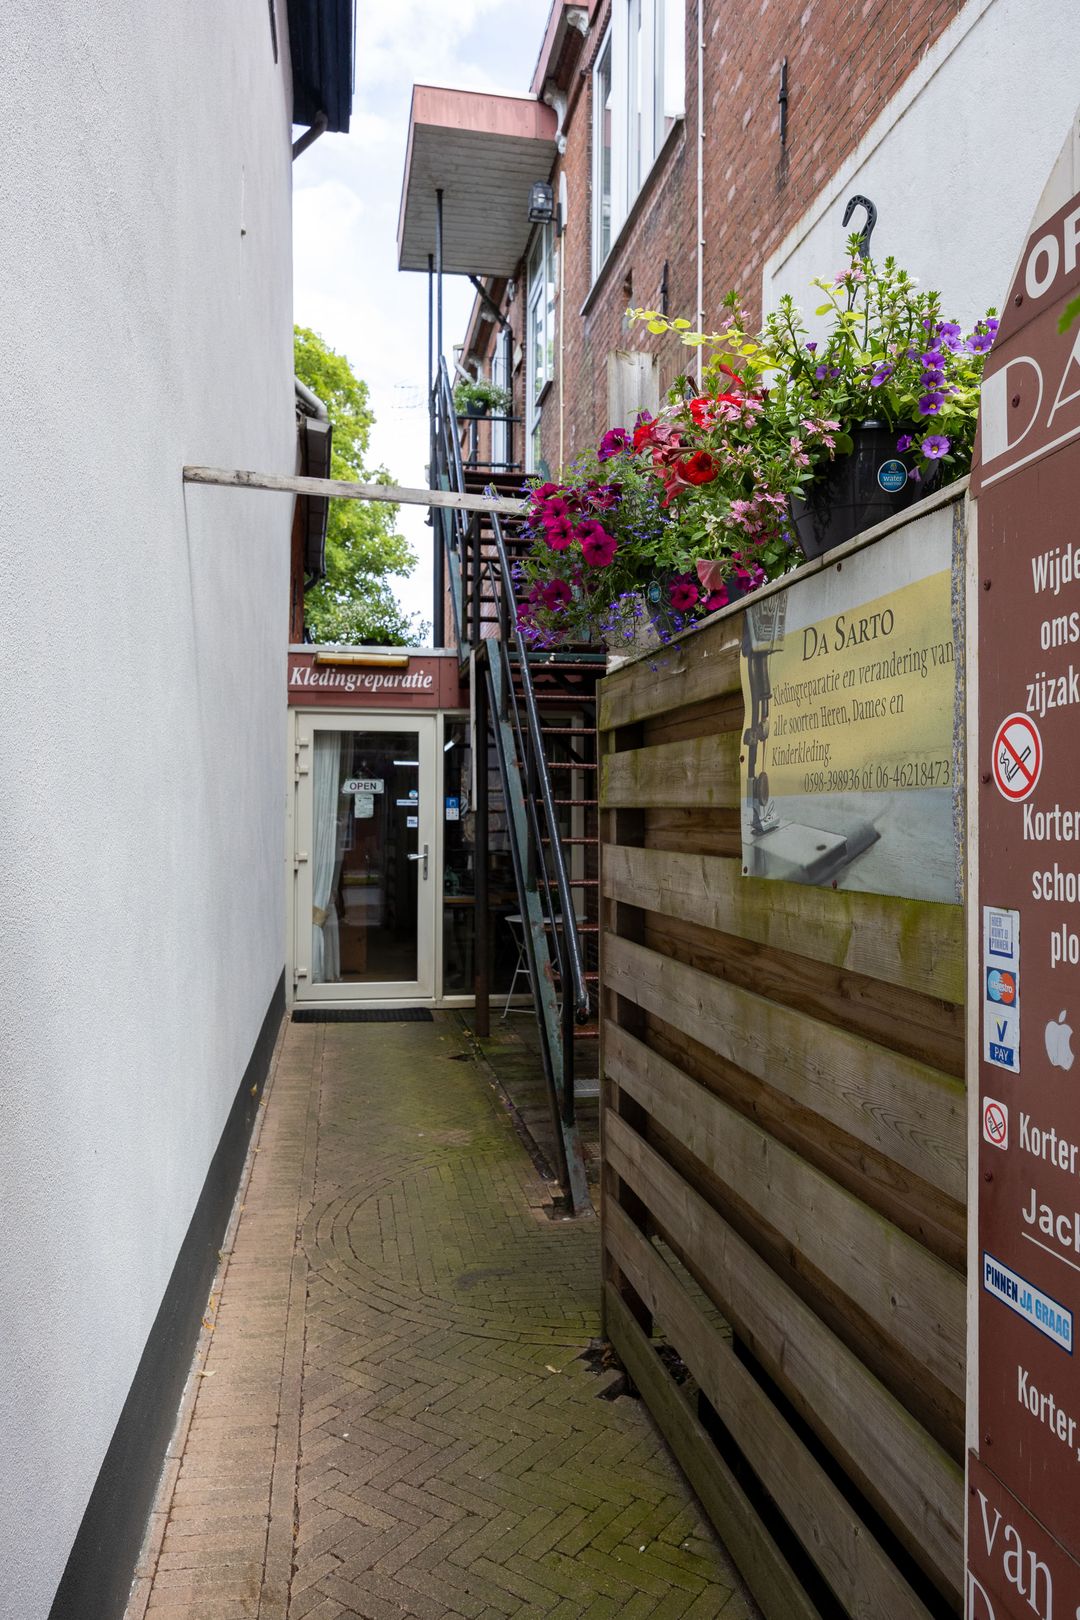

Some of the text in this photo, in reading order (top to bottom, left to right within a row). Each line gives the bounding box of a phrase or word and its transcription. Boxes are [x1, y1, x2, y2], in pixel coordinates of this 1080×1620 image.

[882, 474, 902, 482] water
[289, 666, 433, 692] Kledingreparatie
[772, 641, 954, 708] Kledingreparatie en verandering van
[773, 693, 905, 736] alle soorten Heren, Dames en
[772, 740, 832, 767] Kinderkleding.
[350, 782, 377, 791] OPEN
[804, 760, 950, 793] 0598-398936 of 06-46218473
[994, 1046, 1009, 1061] PAY
[1019, 1112, 1078, 1174] Korter
[986, 1263, 1070, 1341] PINNEN JA GRAAG
[1018, 1365, 1077, 1449] Korter
